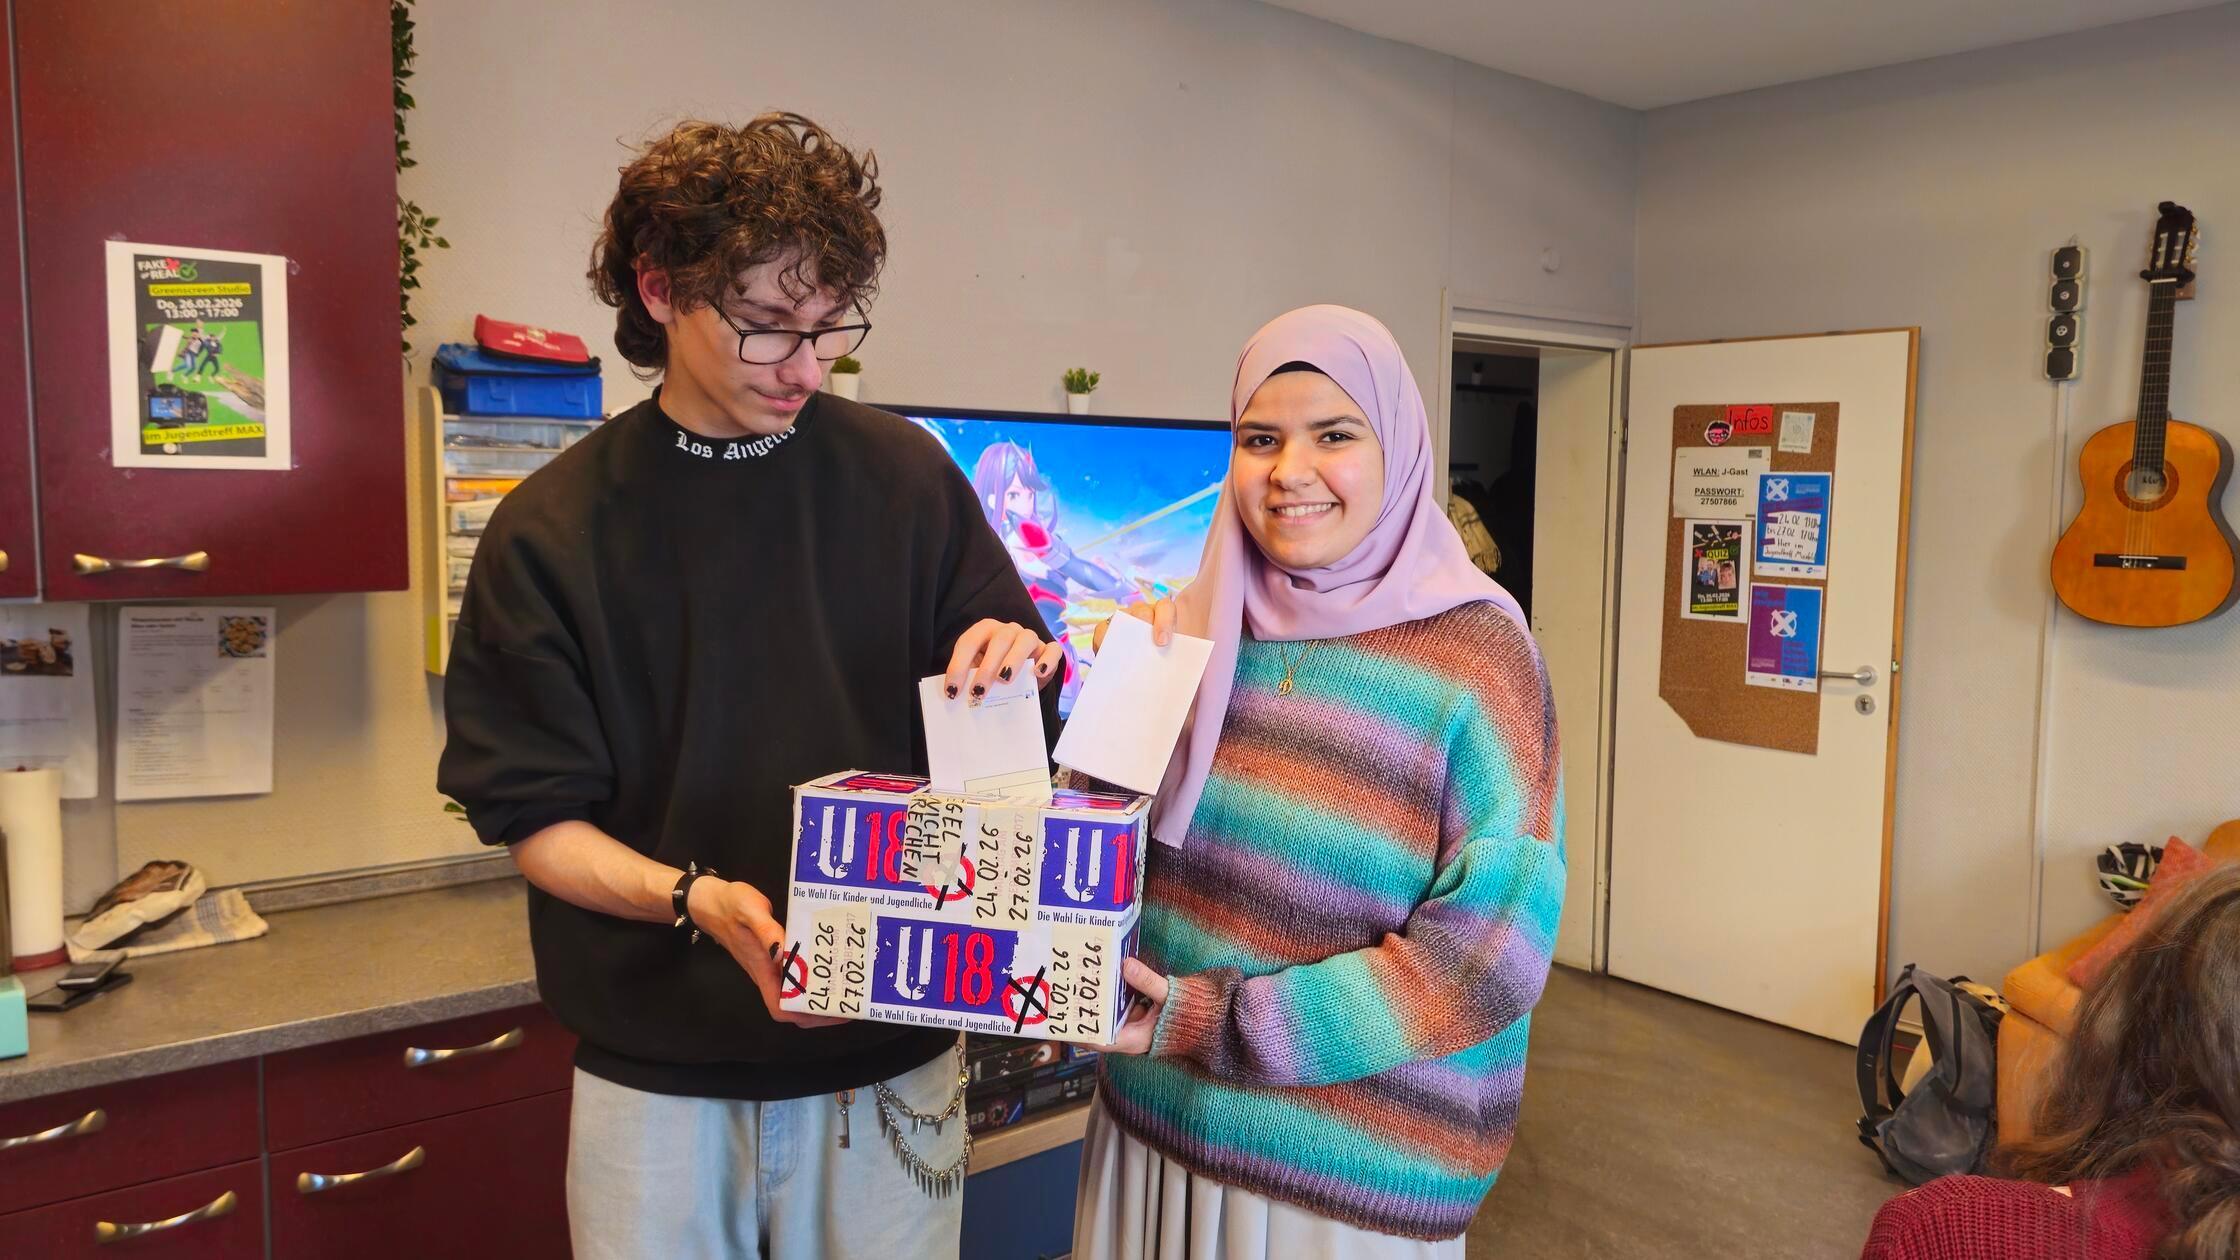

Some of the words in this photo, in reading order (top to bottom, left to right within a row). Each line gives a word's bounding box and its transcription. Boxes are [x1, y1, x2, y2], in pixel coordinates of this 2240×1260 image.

[138, 260, 167, 271] FAKE
[150, 269, 180, 280] REAL
[152, 286, 215, 294] Greenscreen
[218, 285, 250, 293] Studio
[206, 308, 239, 318] 17:00
[1728, 408, 1769, 431] Infos
[164, 427, 233, 441] Jugendtreff
[236, 424, 263, 434] MAX
[675, 431, 713, 458] Los
[1693, 468, 1720, 477] WLAN:
[1721, 468, 1748, 476] J-Gast
[1694, 488, 1744, 497] PASSWORT:
[1707, 549, 1728, 559] QUIZ
[903, 797, 927, 878] RECHEN
[976, 823, 999, 919] 24.02.26
[1008, 831, 1033, 921] 27.02.26
[1062, 826, 1135, 905] U1
[793, 886, 806, 898] Die
[808, 888, 827, 901] Wahl
[829, 890, 841, 902] für
[843, 891, 868, 903] Kinder
[870, 895, 885, 905] und
[886, 896, 933, 910] Jugendliche
[1037, 910, 1051, 921] Die
[1052, 911, 1073, 924] Wahl
[1075, 913, 1087, 925] für
[1089, 915, 1116, 928] Kinder
[808, 922, 834, 1011] 24.02.26
[839, 923, 866, 1013] 27.02.26
[897, 926, 995, 1006] U18
[1048, 947, 1070, 1035] 24.02.26
[1077, 941, 1102, 1034] 27.02.26
[869, 1007, 883, 1019] Die
[884, 1009, 904, 1021] Wahl
[906, 1010, 918, 1023] für
[920, 1012, 945, 1025] Kinder
[948, 1015, 962, 1027] und
[965, 1018, 1011, 1033] Jugendliche
